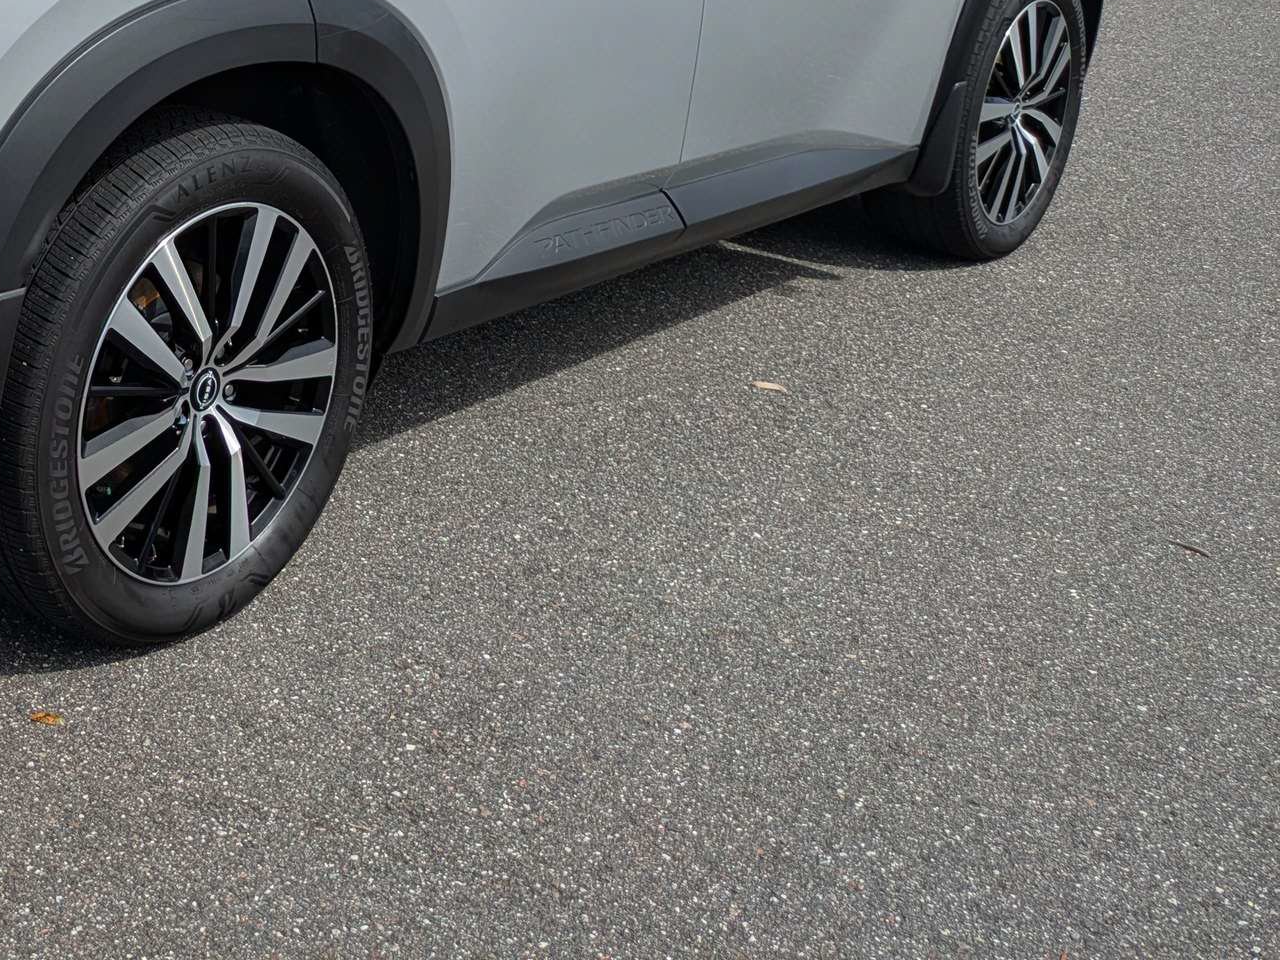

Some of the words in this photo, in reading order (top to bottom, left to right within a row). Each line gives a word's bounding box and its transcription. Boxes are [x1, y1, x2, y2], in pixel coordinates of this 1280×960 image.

[176, 155, 266, 203] ALENZ
[534, 204, 675, 256] PATHFINDER
[343, 245, 371, 432] BRIDGESTONE
[49, 354, 90, 576] BRIDGESTONE
